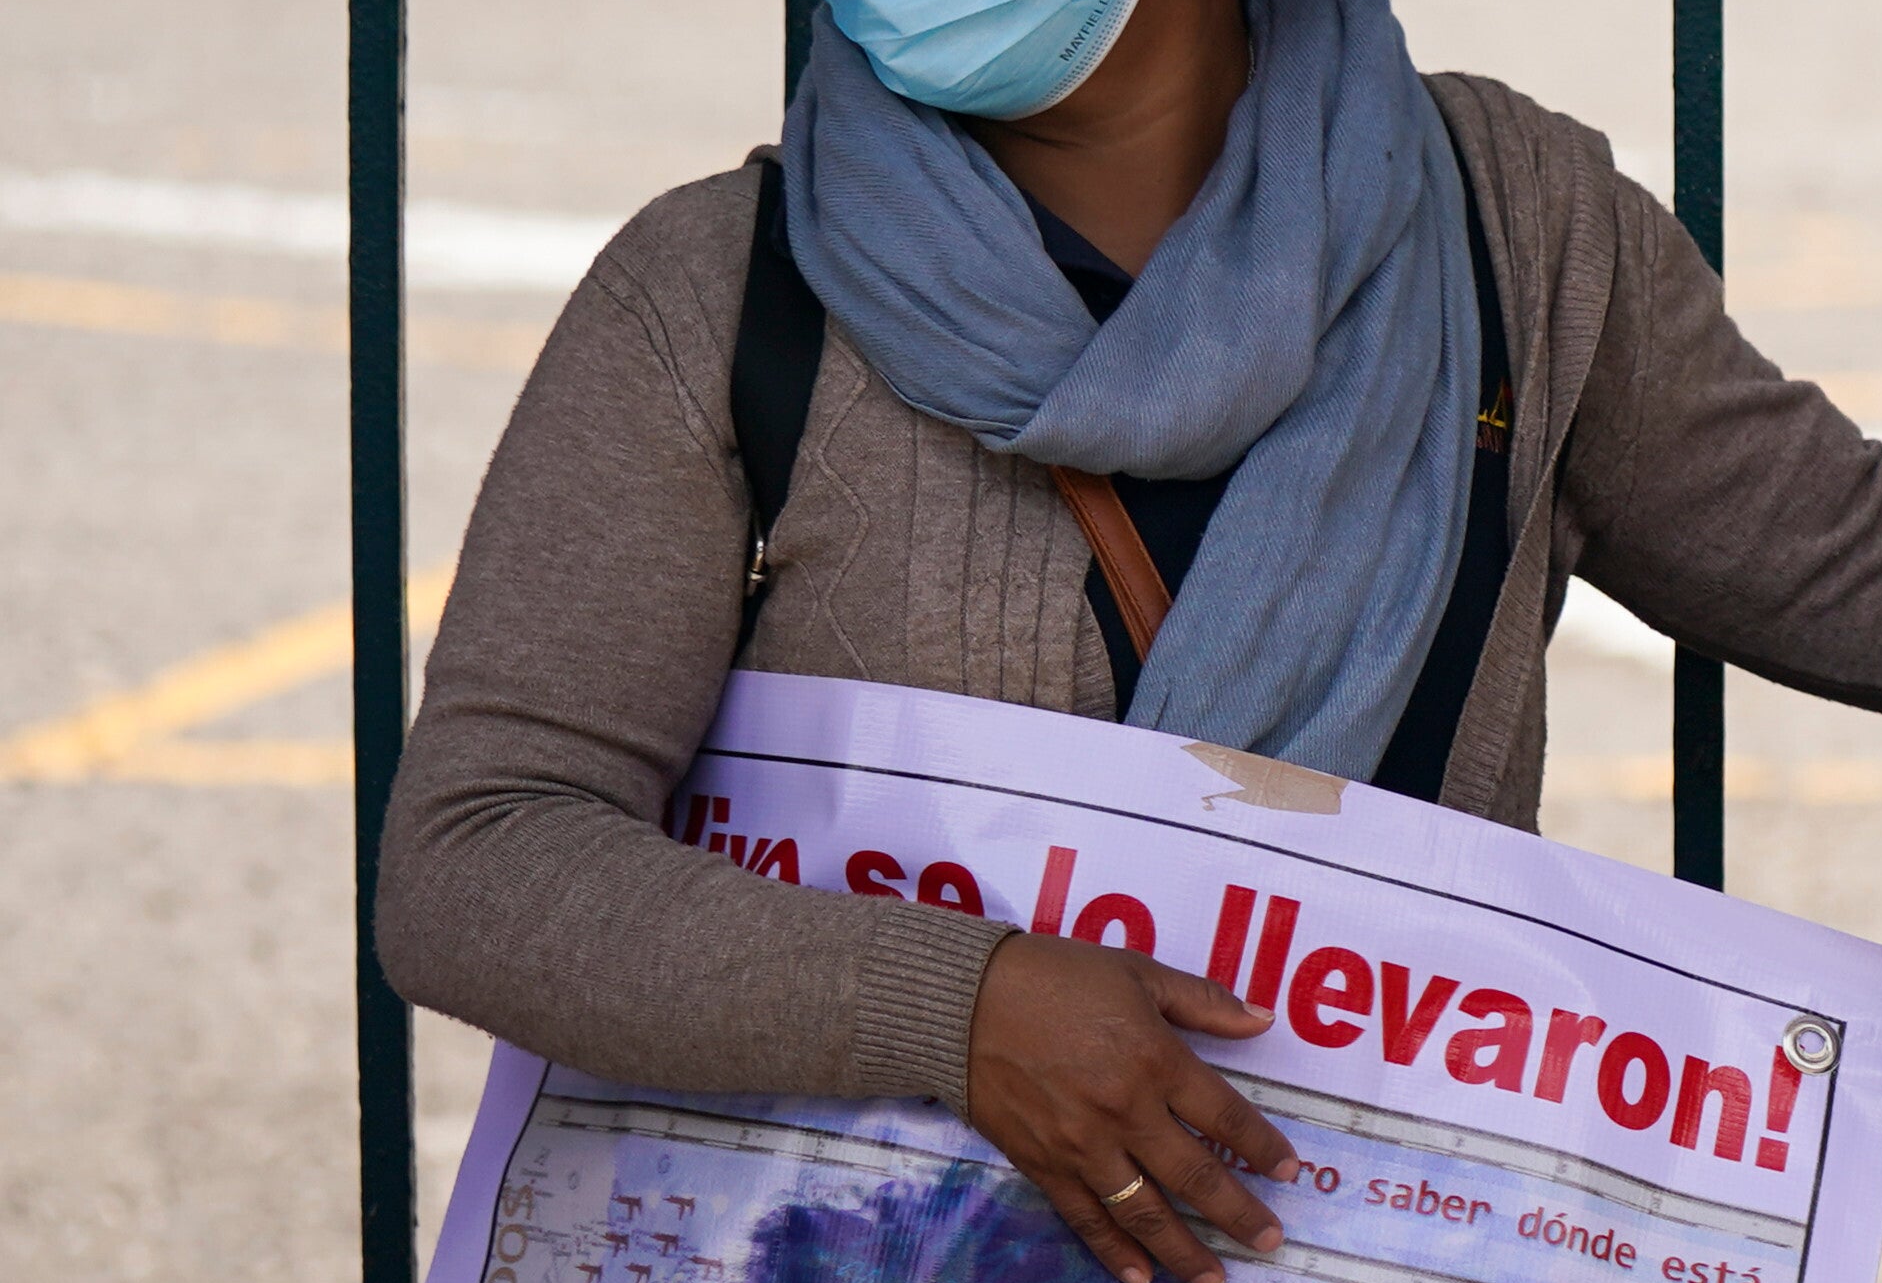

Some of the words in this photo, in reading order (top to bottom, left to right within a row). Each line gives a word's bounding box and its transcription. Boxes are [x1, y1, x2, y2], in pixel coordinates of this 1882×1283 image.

[1205, 884, 1802, 1173] llevaron!
[1364, 1178, 1492, 1225] saber
[1517, 1208, 1637, 1270] dónde
